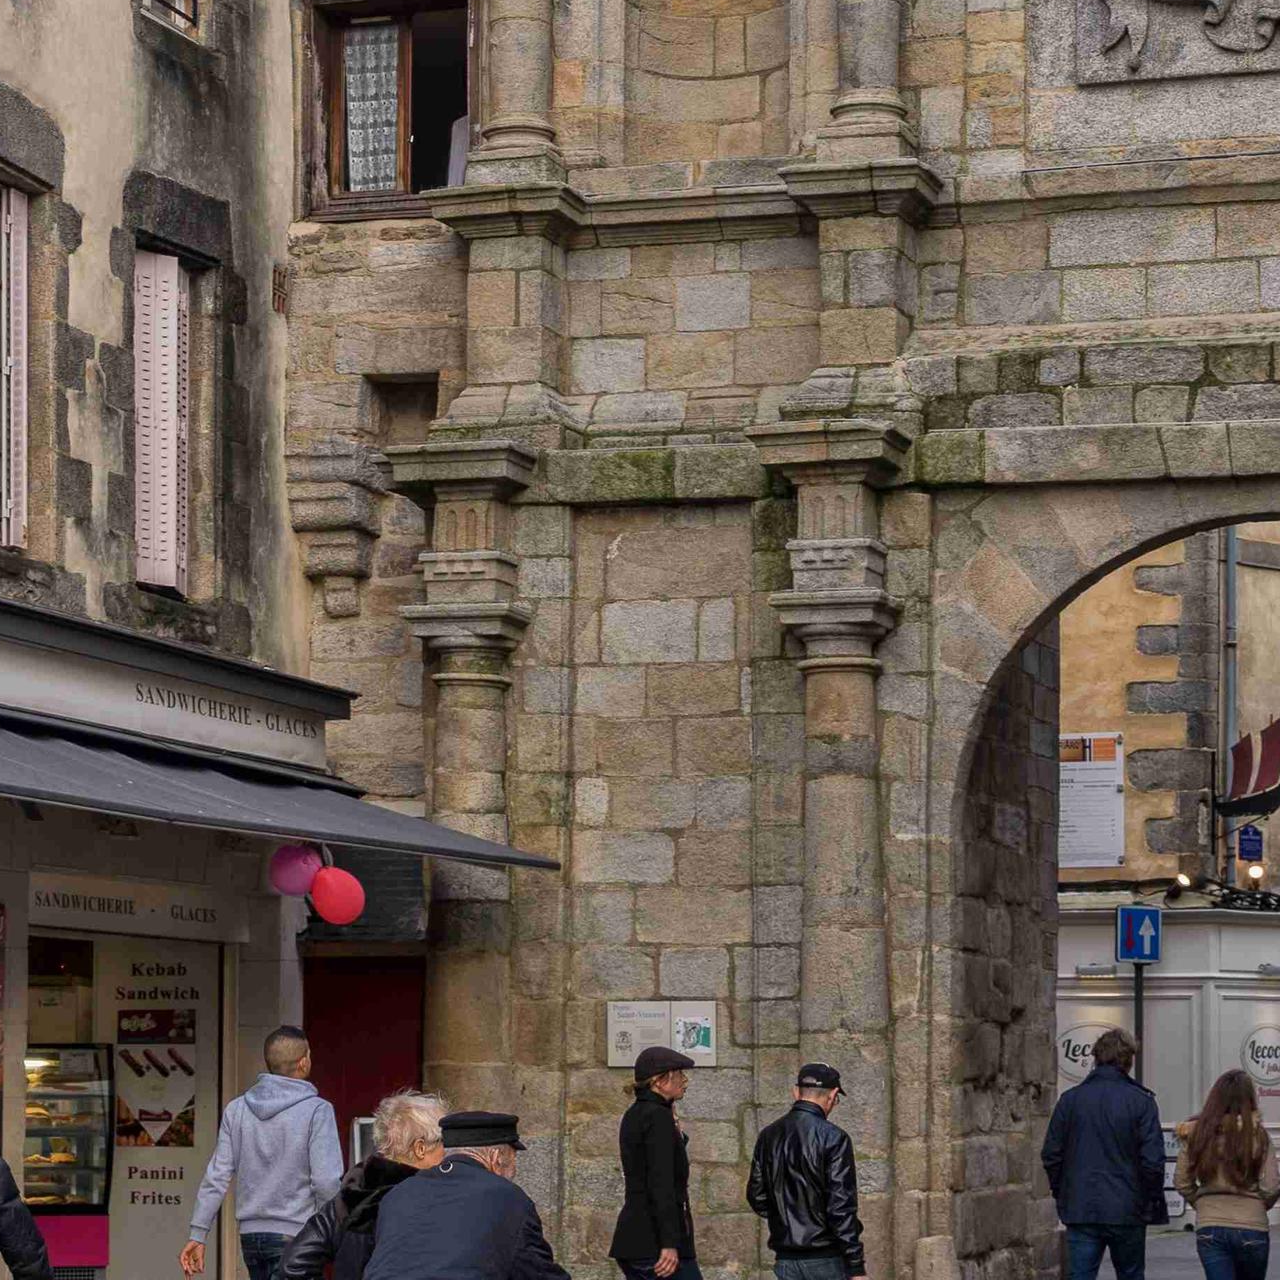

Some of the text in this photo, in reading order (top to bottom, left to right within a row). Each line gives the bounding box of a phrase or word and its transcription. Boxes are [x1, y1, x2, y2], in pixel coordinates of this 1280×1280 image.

[135, 682, 252, 726] SANDWICHERIE
[265, 712, 318, 739] GLACES
[34, 890, 137, 916] SANDWICHERIE
[171, 904, 218, 923] GLACES
[131, 962, 188, 977] Kebab
[115, 986, 201, 1001] Sandwich
[127, 1165, 185, 1180] Panini
[130, 1190, 182, 1205] Frites
